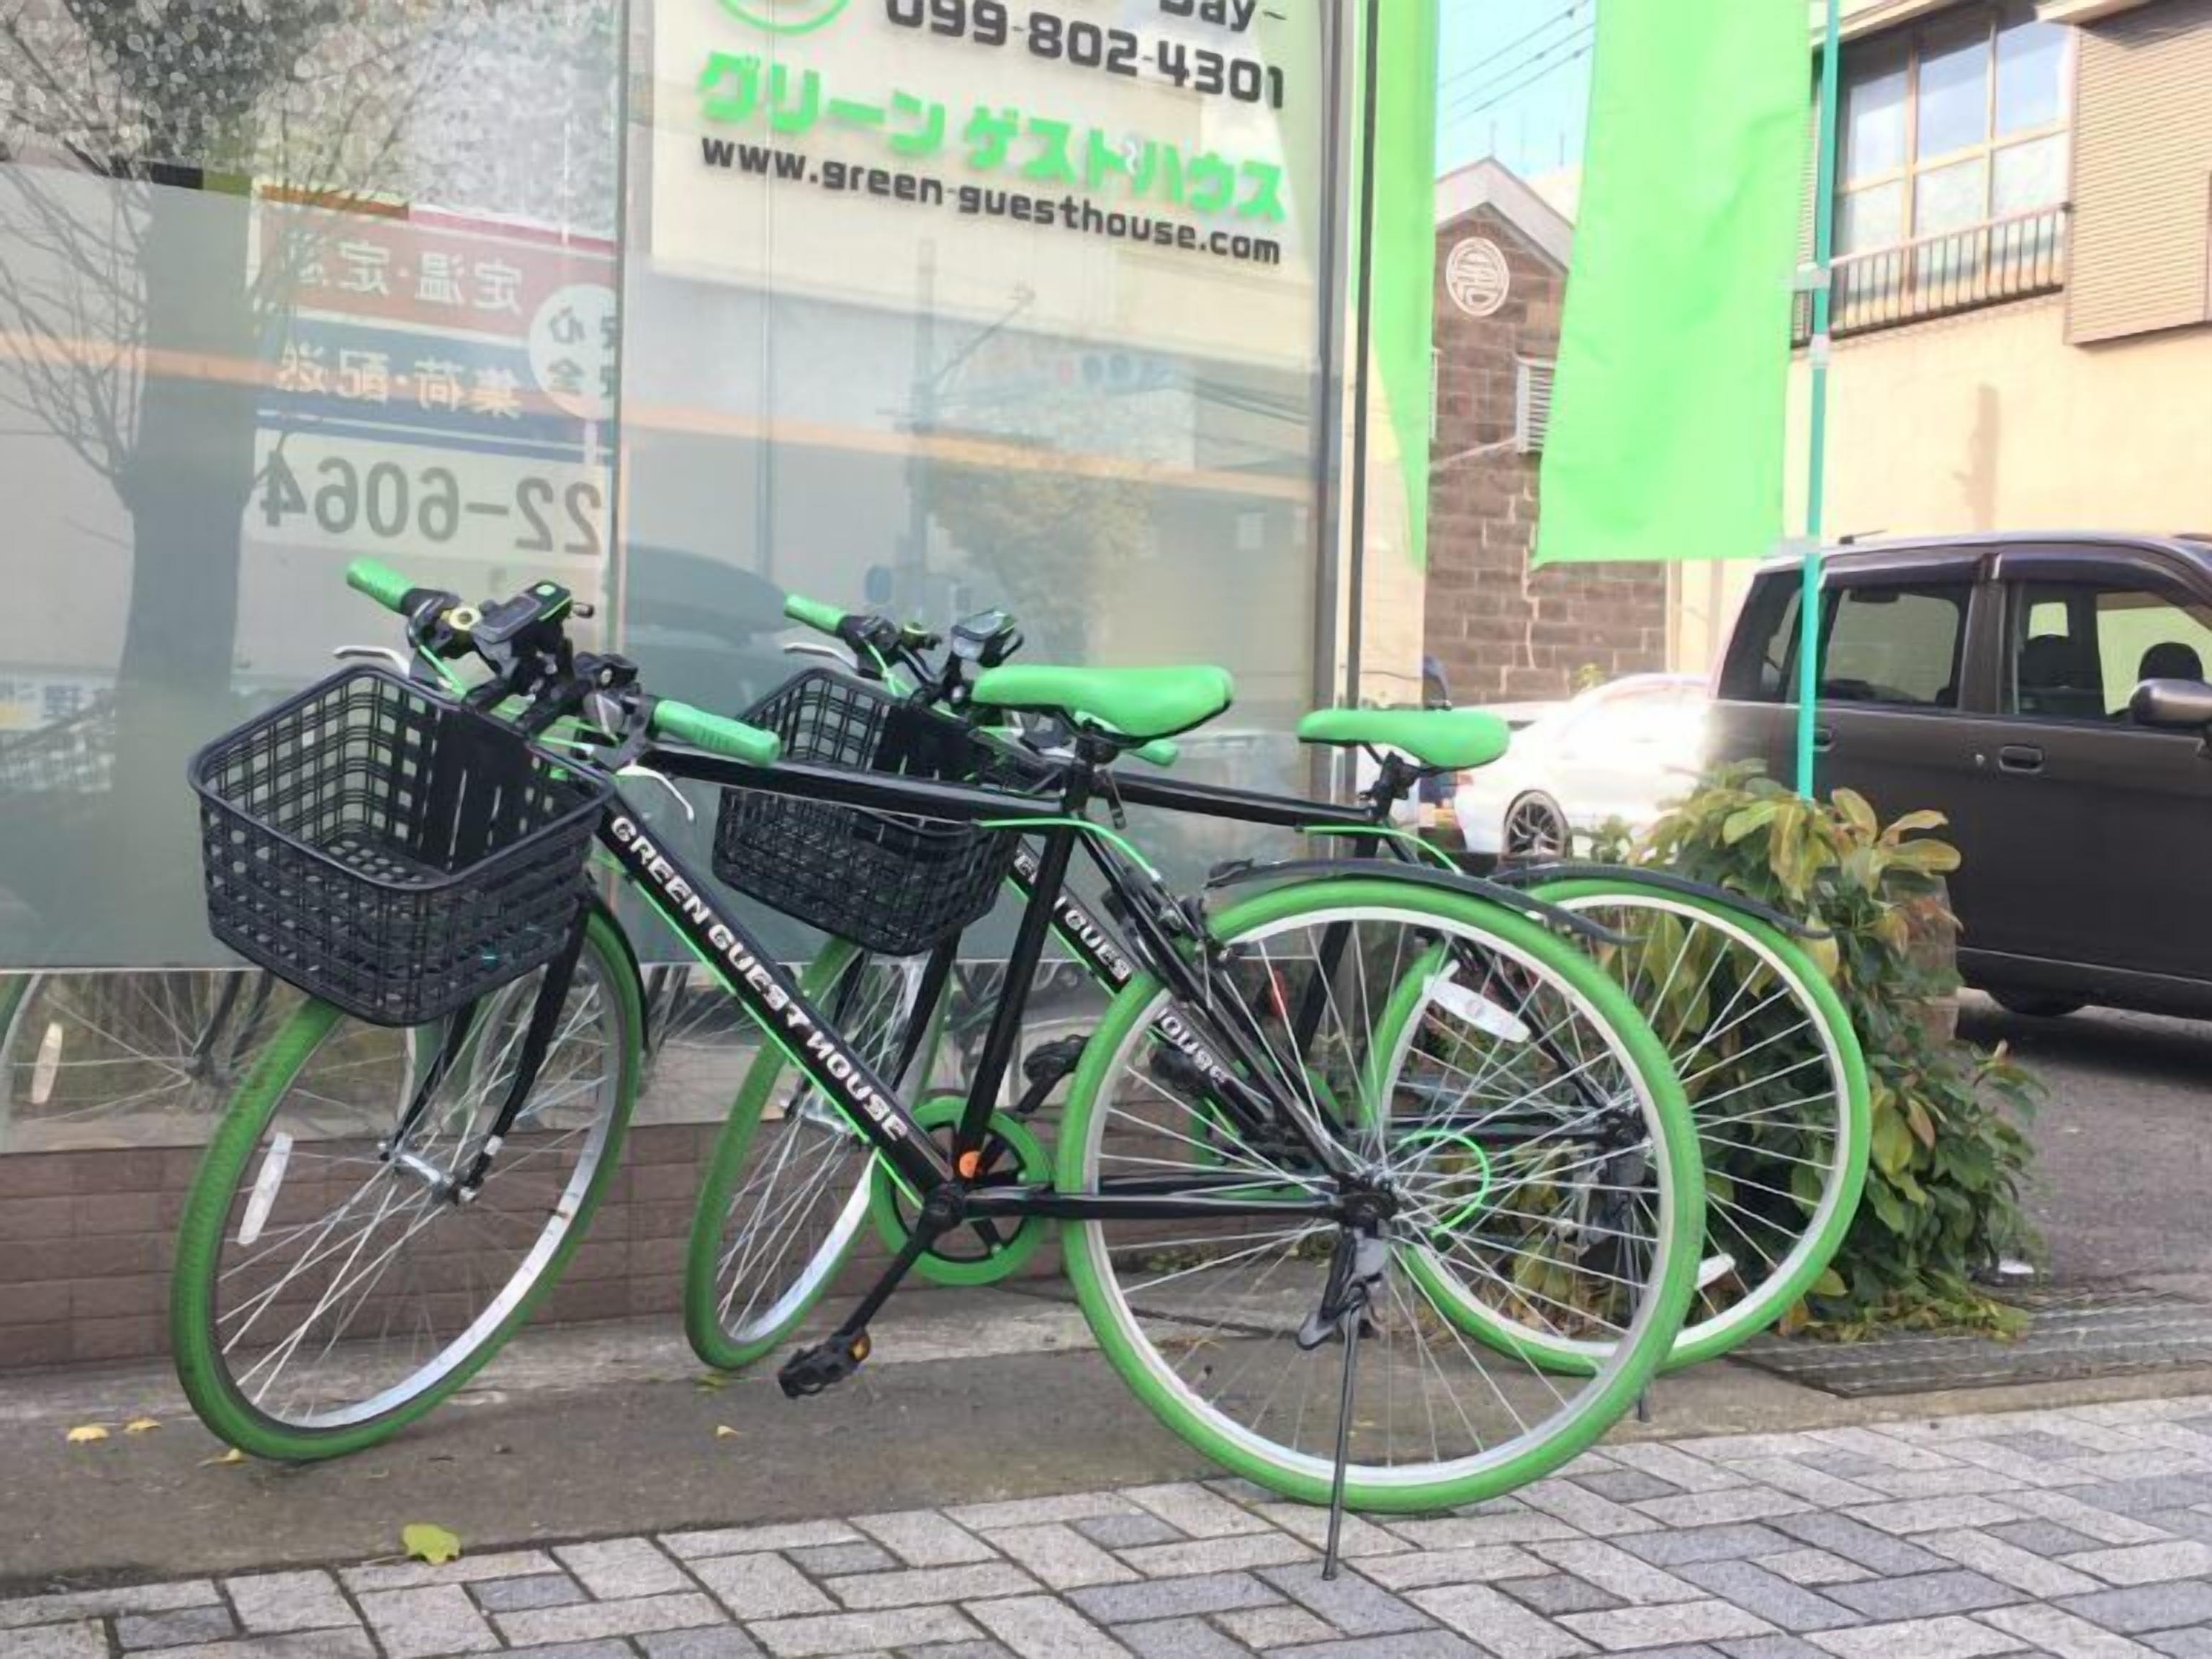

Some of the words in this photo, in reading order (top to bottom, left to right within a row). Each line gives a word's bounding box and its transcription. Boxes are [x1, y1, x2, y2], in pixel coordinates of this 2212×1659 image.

[886, 0, 1284, 109] 099-802-4301
[696, 50, 945, 155] グリーン
[963, 105, 1287, 223] ゲストハウス
[702, 137, 1282, 265] www.green-guesthouse.com
[611, 817, 711, 925] GREEN
[709, 923, 811, 1029] GUEST
[806, 1030, 909, 1141] HOUSE
[1064, 909, 1130, 981] GUES
